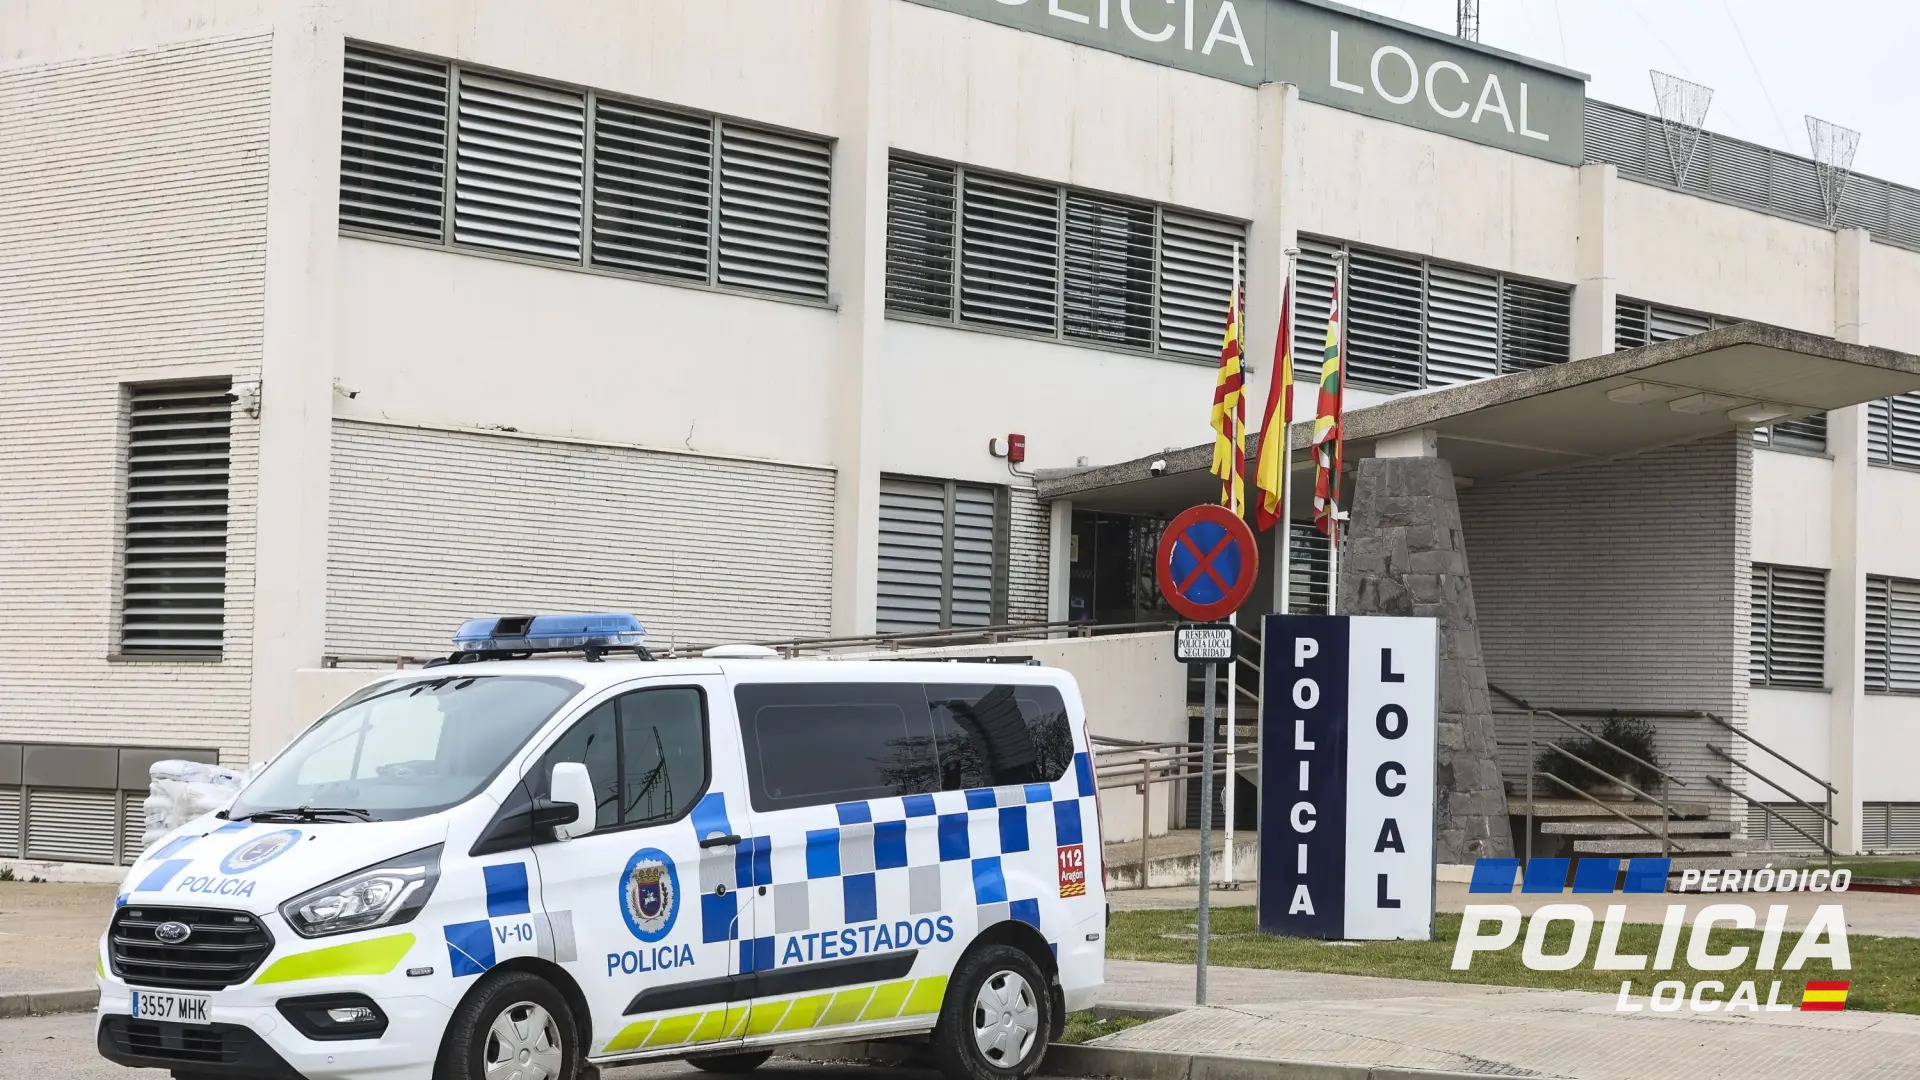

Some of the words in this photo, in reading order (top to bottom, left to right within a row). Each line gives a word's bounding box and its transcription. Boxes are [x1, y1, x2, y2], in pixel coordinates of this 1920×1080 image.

[1330, 30, 1549, 141] LOCAL
[1185, 631, 1226, 639] RESERVADO
[1208, 639, 1230, 648] LOCAL
[1184, 649, 1225, 657] SEGURIDAD
[1288, 637, 1320, 915] POLICIA
[1374, 648, 1408, 908] LOCAL
[1060, 849, 1082, 868] 112
[1061, 869, 1083, 882] Aragón
[176, 876, 256, 898] POLICIA
[159, 924, 181, 938] Ford
[495, 923, 532, 943] V-10
[782, 915, 954, 965] ATESTADOS
[607, 943, 694, 977] POLICIA
[141, 995, 174, 1017] 3557
[179, 998, 207, 1020] MHK
